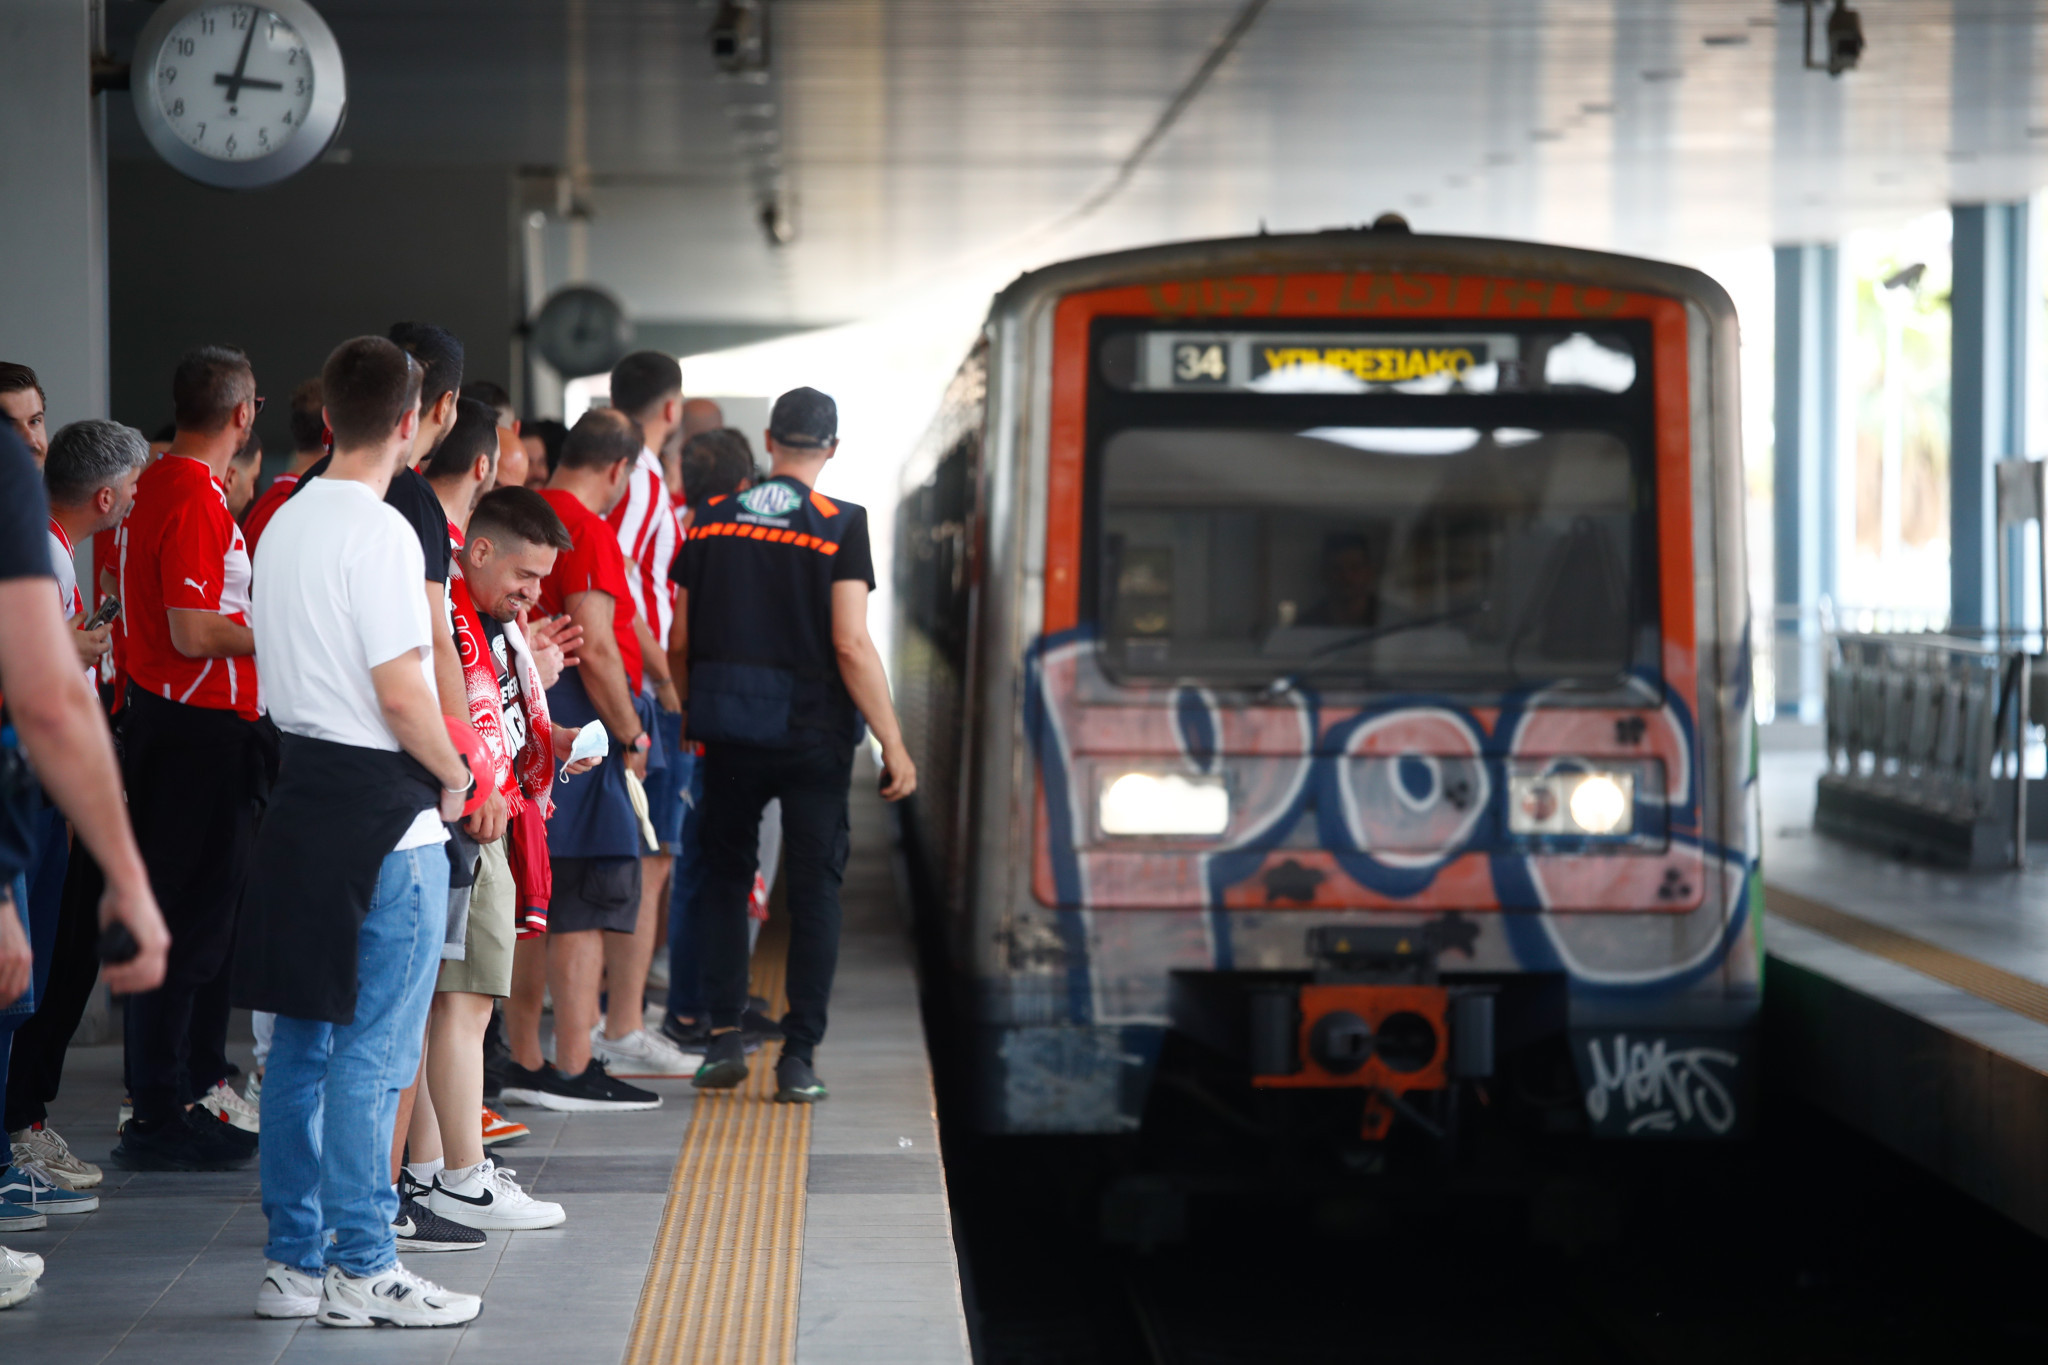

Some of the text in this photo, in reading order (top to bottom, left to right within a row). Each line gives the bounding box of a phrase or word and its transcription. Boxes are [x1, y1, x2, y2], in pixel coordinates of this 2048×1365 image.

[202, 17, 214, 35] 11
[231, 11, 248, 30] 12
[178, 38, 194, 57] 10
[288, 47, 297, 66] 2
[166, 67, 177, 84] 9
[295, 78, 305, 96] 3
[173, 98, 185, 116] 8
[282, 109, 292, 125] 4
[197, 122, 206, 141] 7
[259, 128, 268, 146] 5
[226, 134, 236, 152] 6
[1176, 345, 1226, 380] 34
